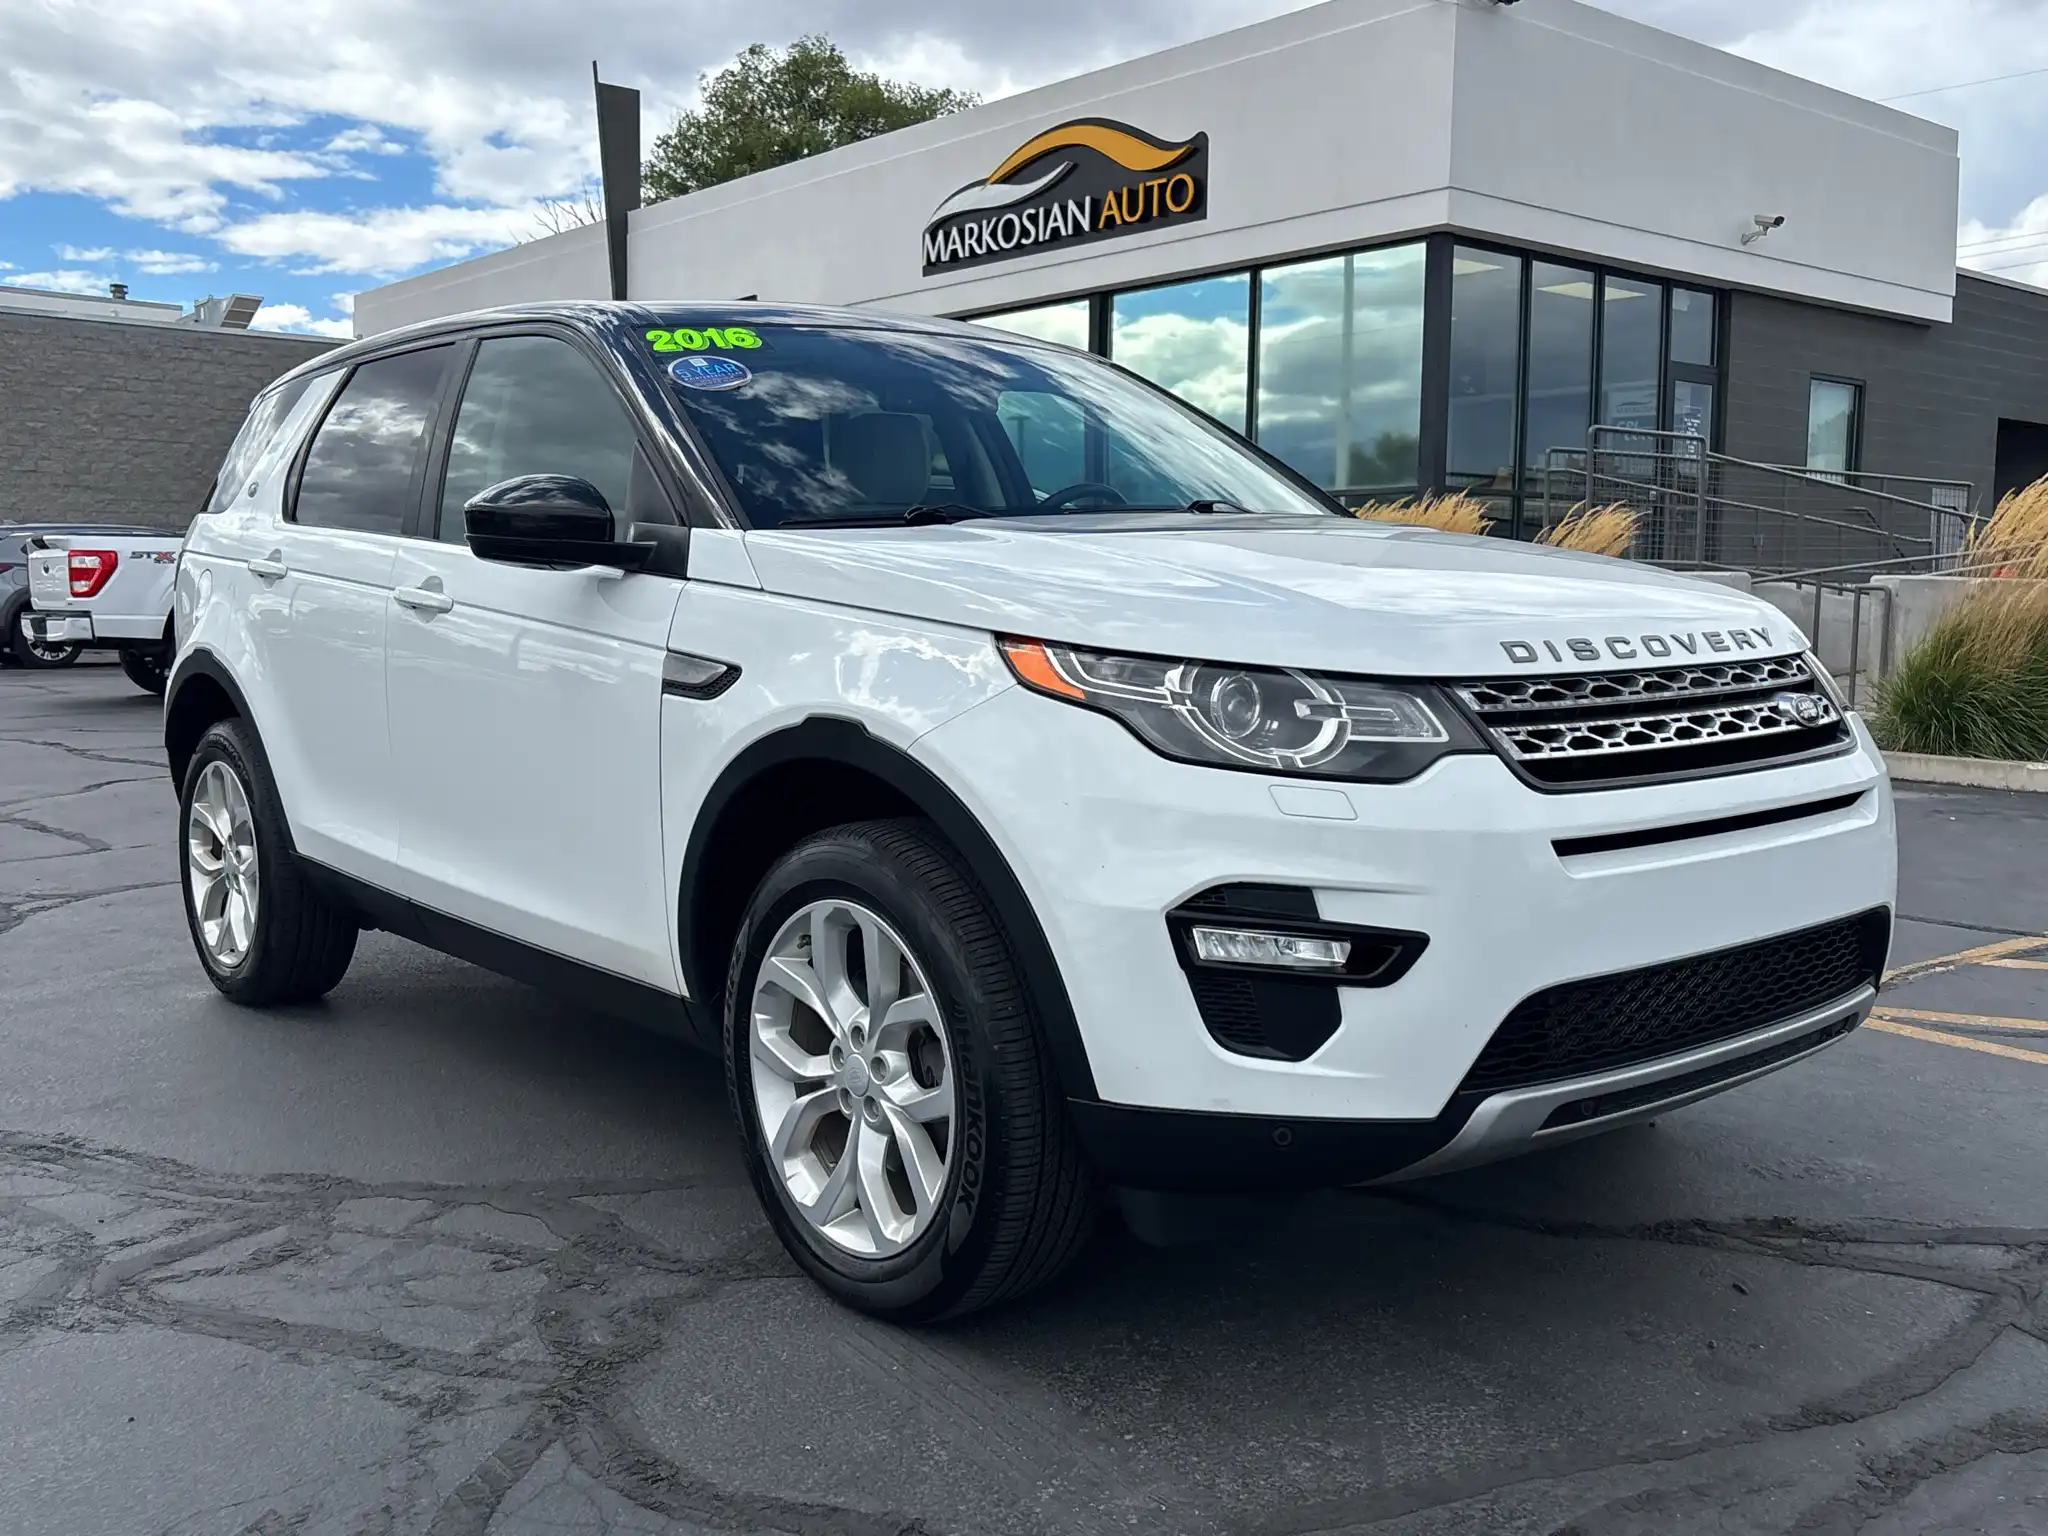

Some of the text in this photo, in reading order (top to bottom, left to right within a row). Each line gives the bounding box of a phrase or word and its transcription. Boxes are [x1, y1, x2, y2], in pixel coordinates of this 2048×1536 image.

[922, 173, 1195, 266] MARKOSIAN AUTO
[646, 328, 763, 352] 2016
[674, 363, 740, 378] 5 YEAR
[129, 551, 177, 562] STX
[1500, 627, 1775, 663] DISCOVERY
